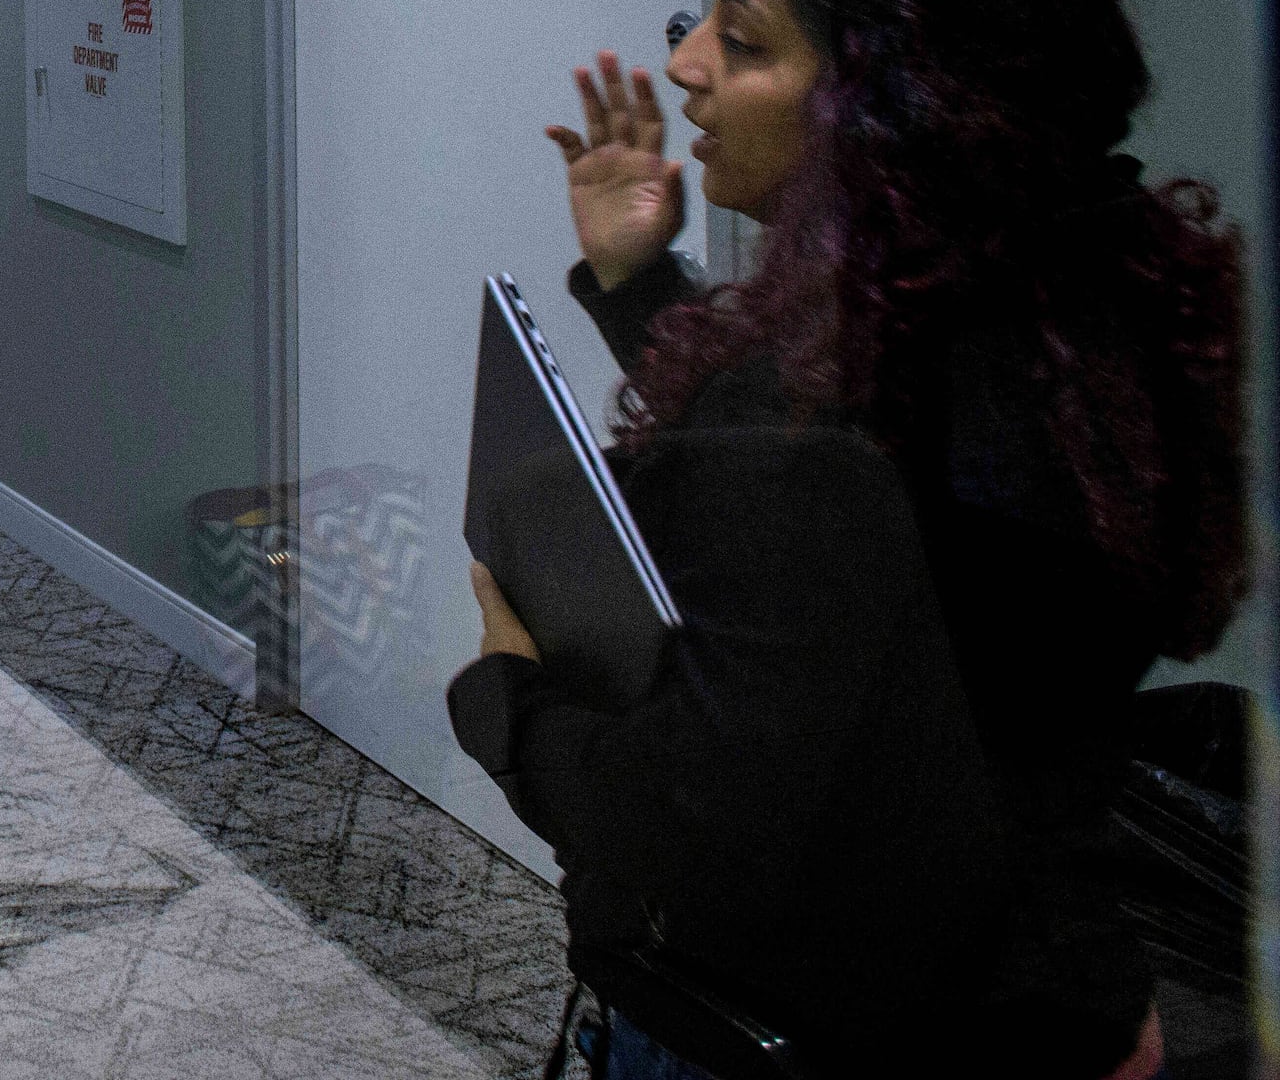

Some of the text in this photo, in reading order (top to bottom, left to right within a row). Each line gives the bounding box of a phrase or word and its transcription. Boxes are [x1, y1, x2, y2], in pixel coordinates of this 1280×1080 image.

[88, 22, 103, 44] FIRE
[73, 45, 119, 73] DEPARTMENT
[85, 73, 107, 96] VALVE
